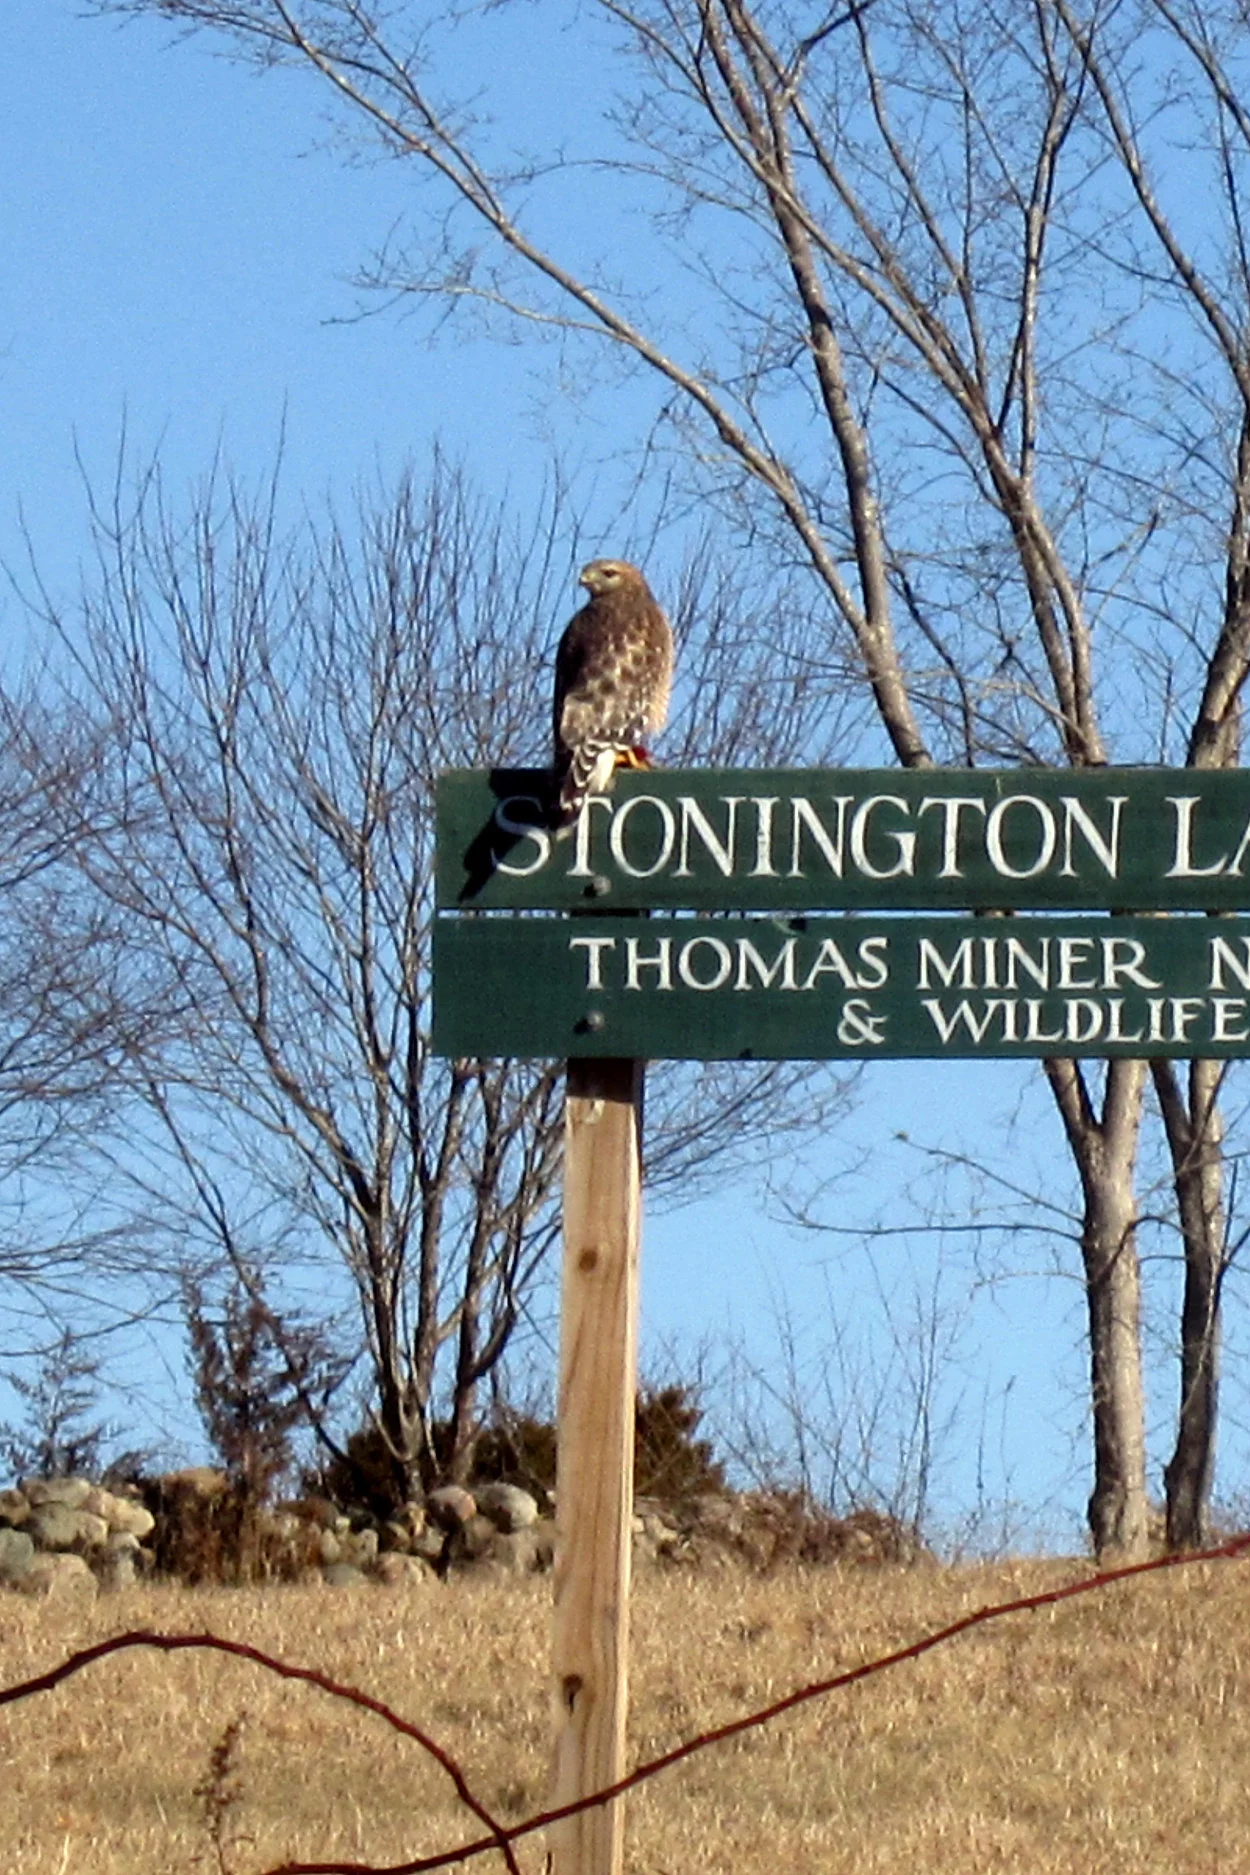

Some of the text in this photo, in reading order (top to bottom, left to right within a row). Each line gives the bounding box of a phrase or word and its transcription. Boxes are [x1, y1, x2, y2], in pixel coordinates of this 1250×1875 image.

[490, 794, 1129, 879] STONINGTON
[569, 936, 890, 991] THOMAS
[916, 936, 1162, 991] MINER
[836, 998, 887, 1046] &
[921, 998, 1250, 1045] WILDLIFE
